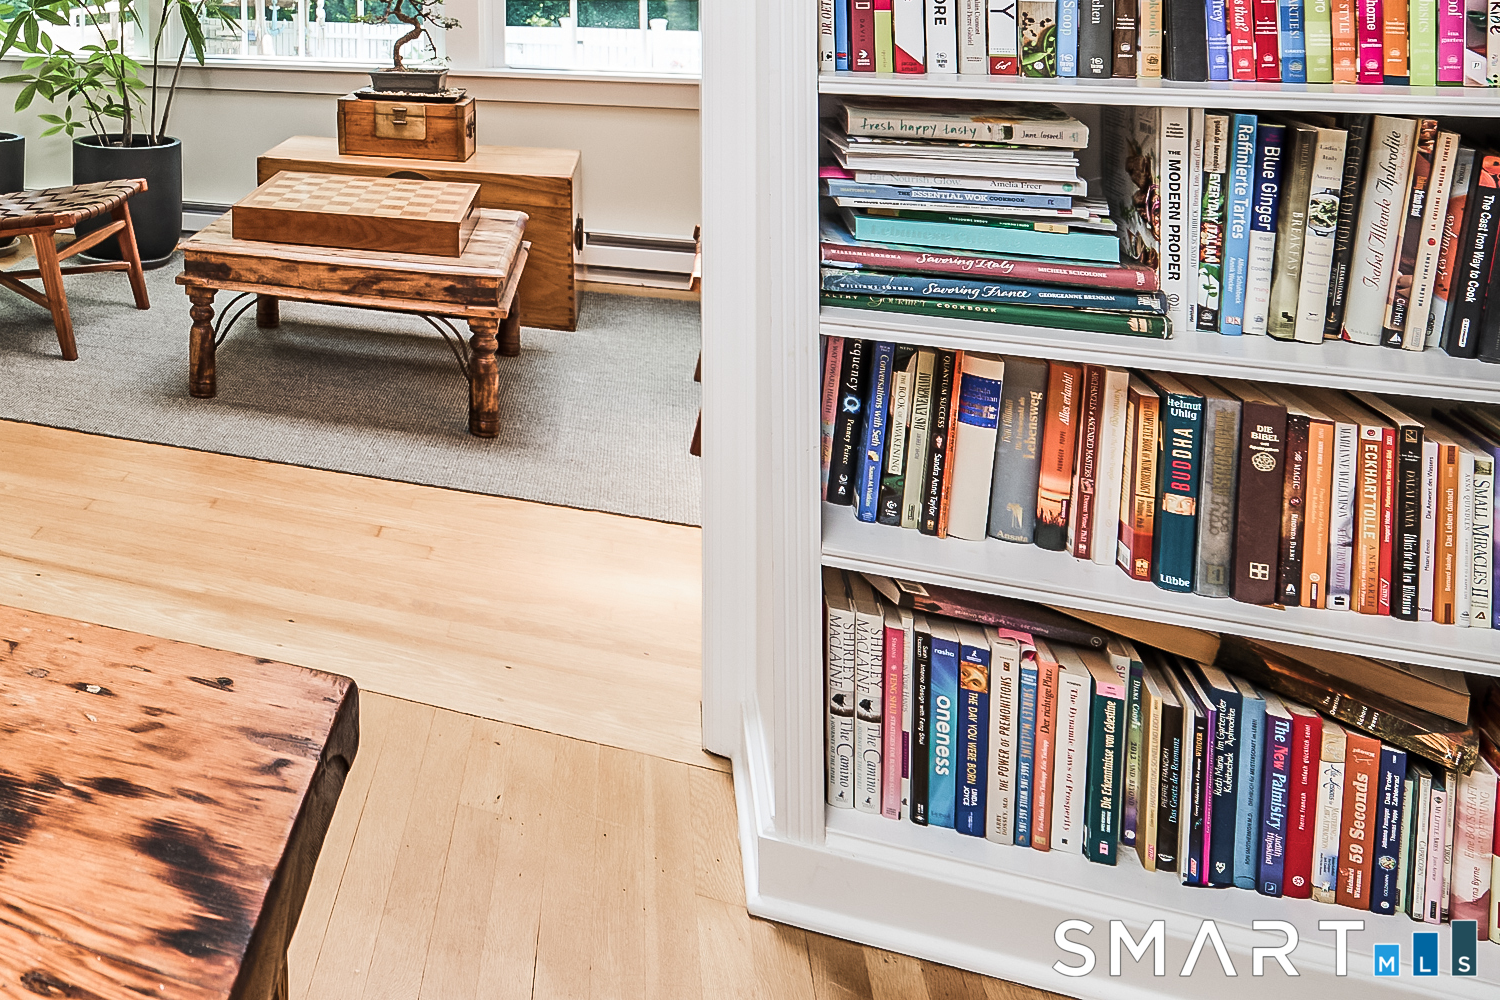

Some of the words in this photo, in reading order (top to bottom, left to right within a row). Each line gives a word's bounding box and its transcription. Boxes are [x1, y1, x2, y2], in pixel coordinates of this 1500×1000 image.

[1234, 124, 1253, 196] Raffinierte
[1263, 146, 1280, 179] Blue
[1168, 159, 1181, 220] MODERN
[1482, 195, 1495, 211] The
[1232, 198, 1249, 239] Tartes
[1255, 182, 1277, 231] Ginger
[1479, 212, 1491, 232] Cast
[1168, 224, 1181, 281] PROPER
[1287, 212, 1304, 279] BREAKFAST
[1475, 232, 1488, 250] Iron
[916, 253, 974, 271] Savoring
[975, 259, 1015, 273] Italy
[1470, 251, 1485, 270] Way
[1470, 271, 1480, 279] to
[1465, 280, 1479, 302] Cook
[874, 354, 890, 409] Conversations
[873, 410, 884, 428] with
[1022, 391, 1043, 460] Lebensweg
[871, 429, 881, 446] Seth
[1170, 428, 1193, 492] BUDDHA
[1364, 444, 1378, 501] ECKHART
[1473, 480, 1490, 520] SMALL
[1364, 502, 1377, 540] TOLLE
[1471, 523, 1490, 586] MIRACLES
[1159, 574, 1190, 587] Lübbe
[843, 622, 855, 683] SHIRLEY
[969, 692, 978, 705] THE
[968, 706, 978, 722] DAY
[839, 718, 852, 742] The
[935, 695, 952, 776] oneness
[967, 724, 977, 741] YOU
[1273, 719, 1290, 743] The
[837, 743, 853, 788] Camino
[967, 742, 977, 762] WERE
[1273, 744, 1288, 770] New
[966, 763, 977, 785] BORN
[1266, 772, 1288, 831] Palmistry
[1349, 772, 1368, 840] Seconds
[1349, 845, 1362, 864] 59
